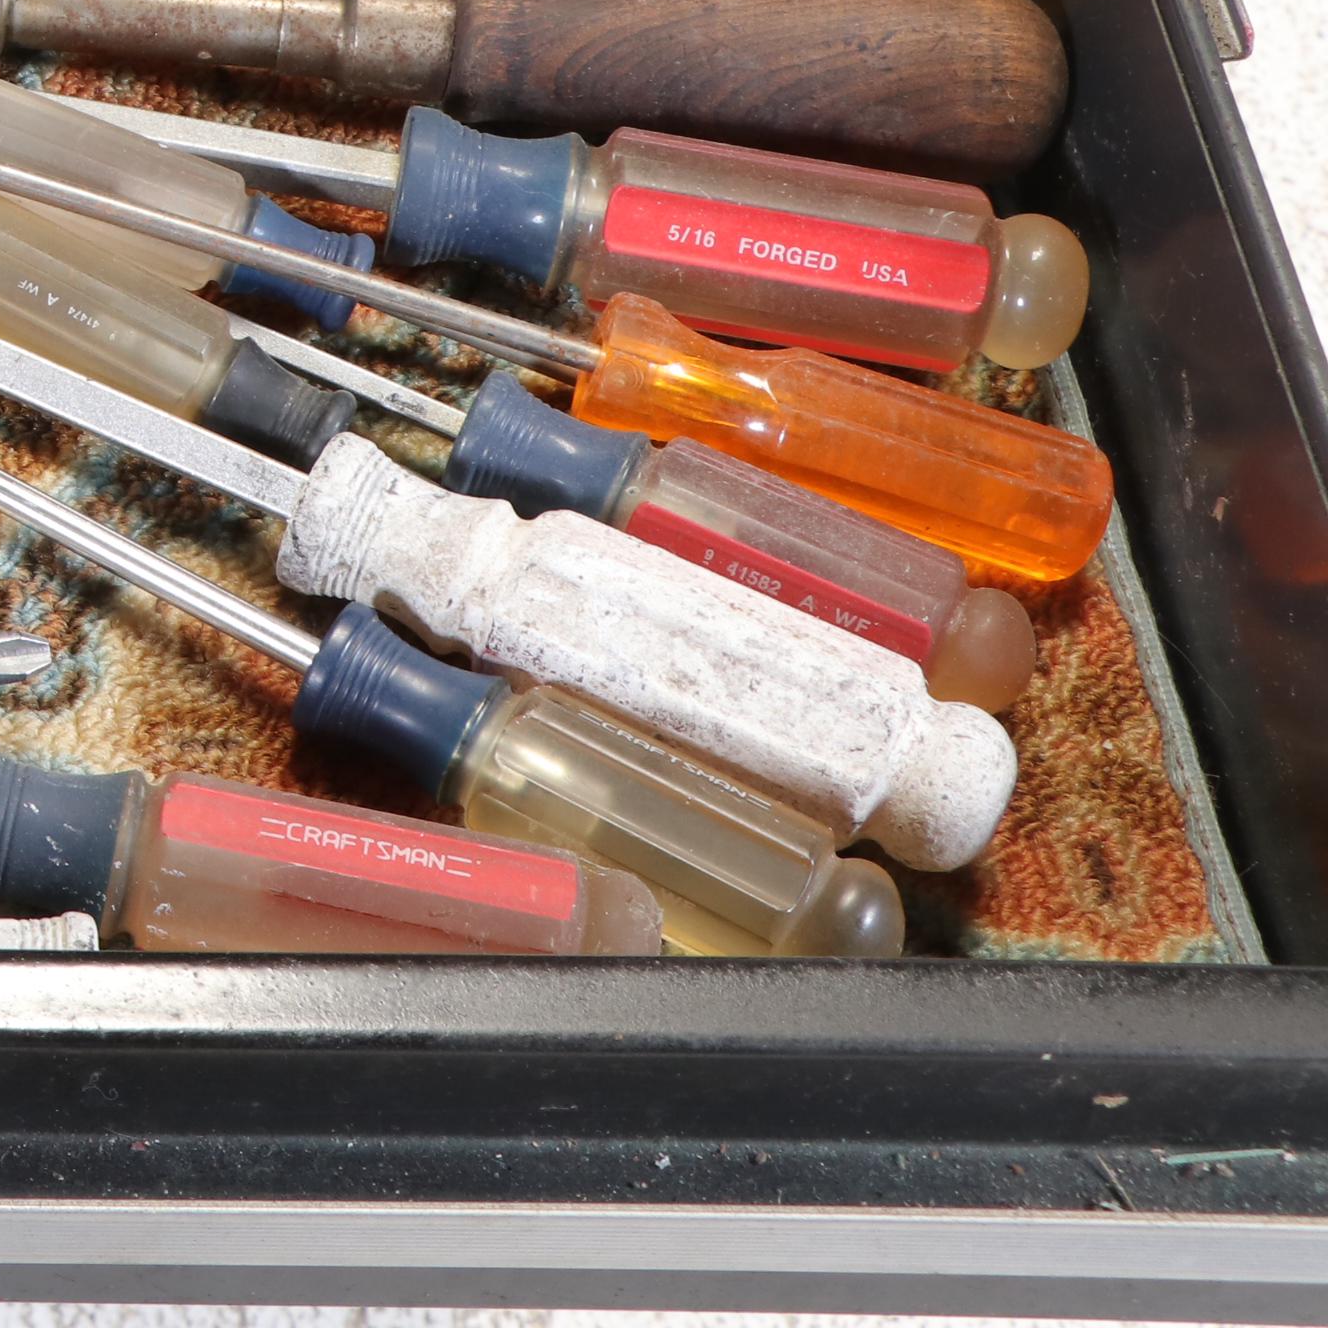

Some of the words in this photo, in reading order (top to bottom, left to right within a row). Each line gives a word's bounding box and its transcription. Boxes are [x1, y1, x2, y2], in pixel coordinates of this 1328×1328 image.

[667, 223, 716, 249] 5/16
[738, 236, 838, 272] FORGED
[861, 260, 909, 287] USA
[17, 279, 39, 296] WF
[47, 292, 60, 306] A
[68, 306, 101, 329] 41474
[727, 561, 782, 596] 41582
[798, 594, 817, 612] A
[834, 608, 872, 633] WF
[600, 721, 746, 798] CRAFTSMAN
[286, 822, 446, 872] CRAFTSMAN
